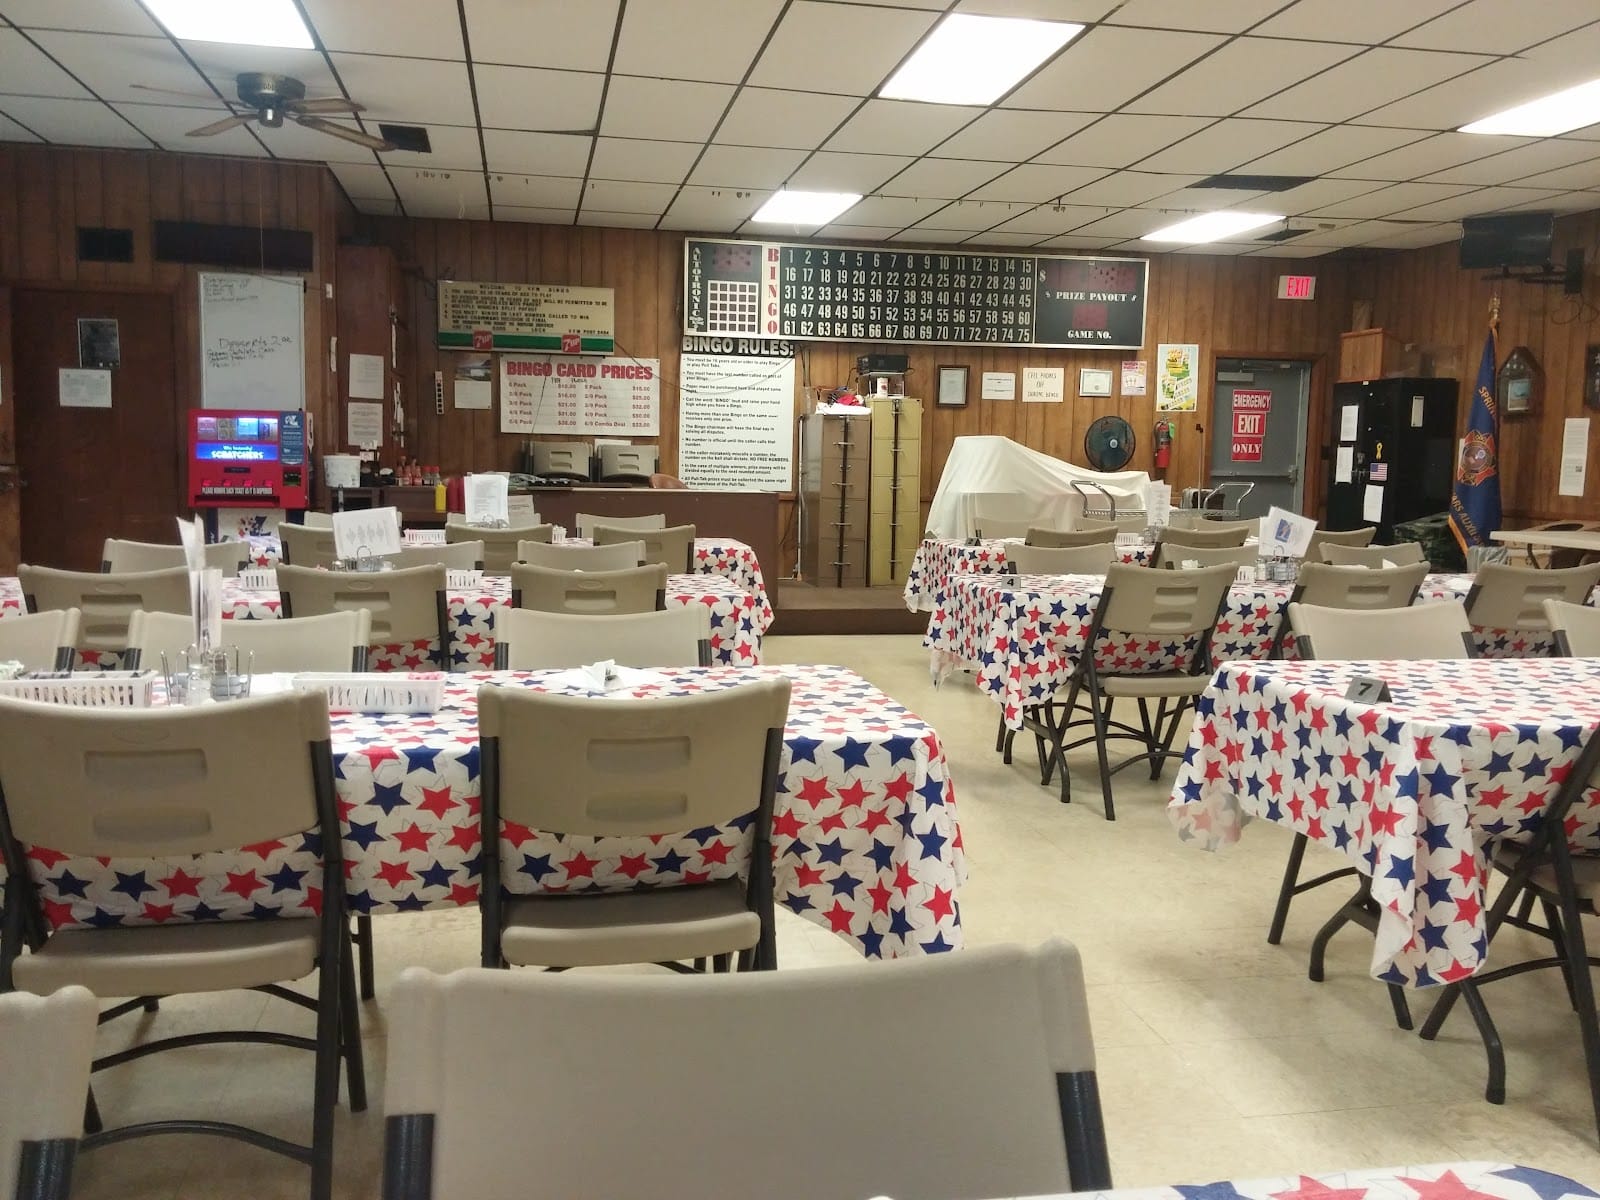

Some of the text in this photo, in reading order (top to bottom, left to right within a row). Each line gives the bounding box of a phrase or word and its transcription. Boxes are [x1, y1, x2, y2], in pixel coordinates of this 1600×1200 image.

[788, 249, 1032, 274] 1 2 3 4 5 6 7 8 9 10 11 12 13 14 15
[785, 267, 1032, 290] 16 17 18 19 20 21 22 23 24 25 26 27 28 29 30
[1286, 277, 1311, 297] EXIT
[784, 285, 1031, 308] 31 32 33 34 35 36 37 38 39 40 41 42 43 44 45
[1056, 292, 1128, 302] PRIZE PAYOUT
[784, 303, 1030, 325] 46 47 48 49 50 51 52 53 54 55 56 57 58 59 60
[784, 320, 1030, 342] 61 62 63 64 65 66 67 68 69 70 71 72 73 74 75
[1068, 330, 1112, 340] GAME NO.
[682, 336, 794, 357] BINGO RULES:
[506, 361, 653, 380] BINGO CARD PRICES
[1233, 394, 1271, 409] EMERGENCY
[1238, 414, 1261, 434] EXIT
[1233, 443, 1262, 454] ONLY
[1358, 682, 1373, 696] 7
